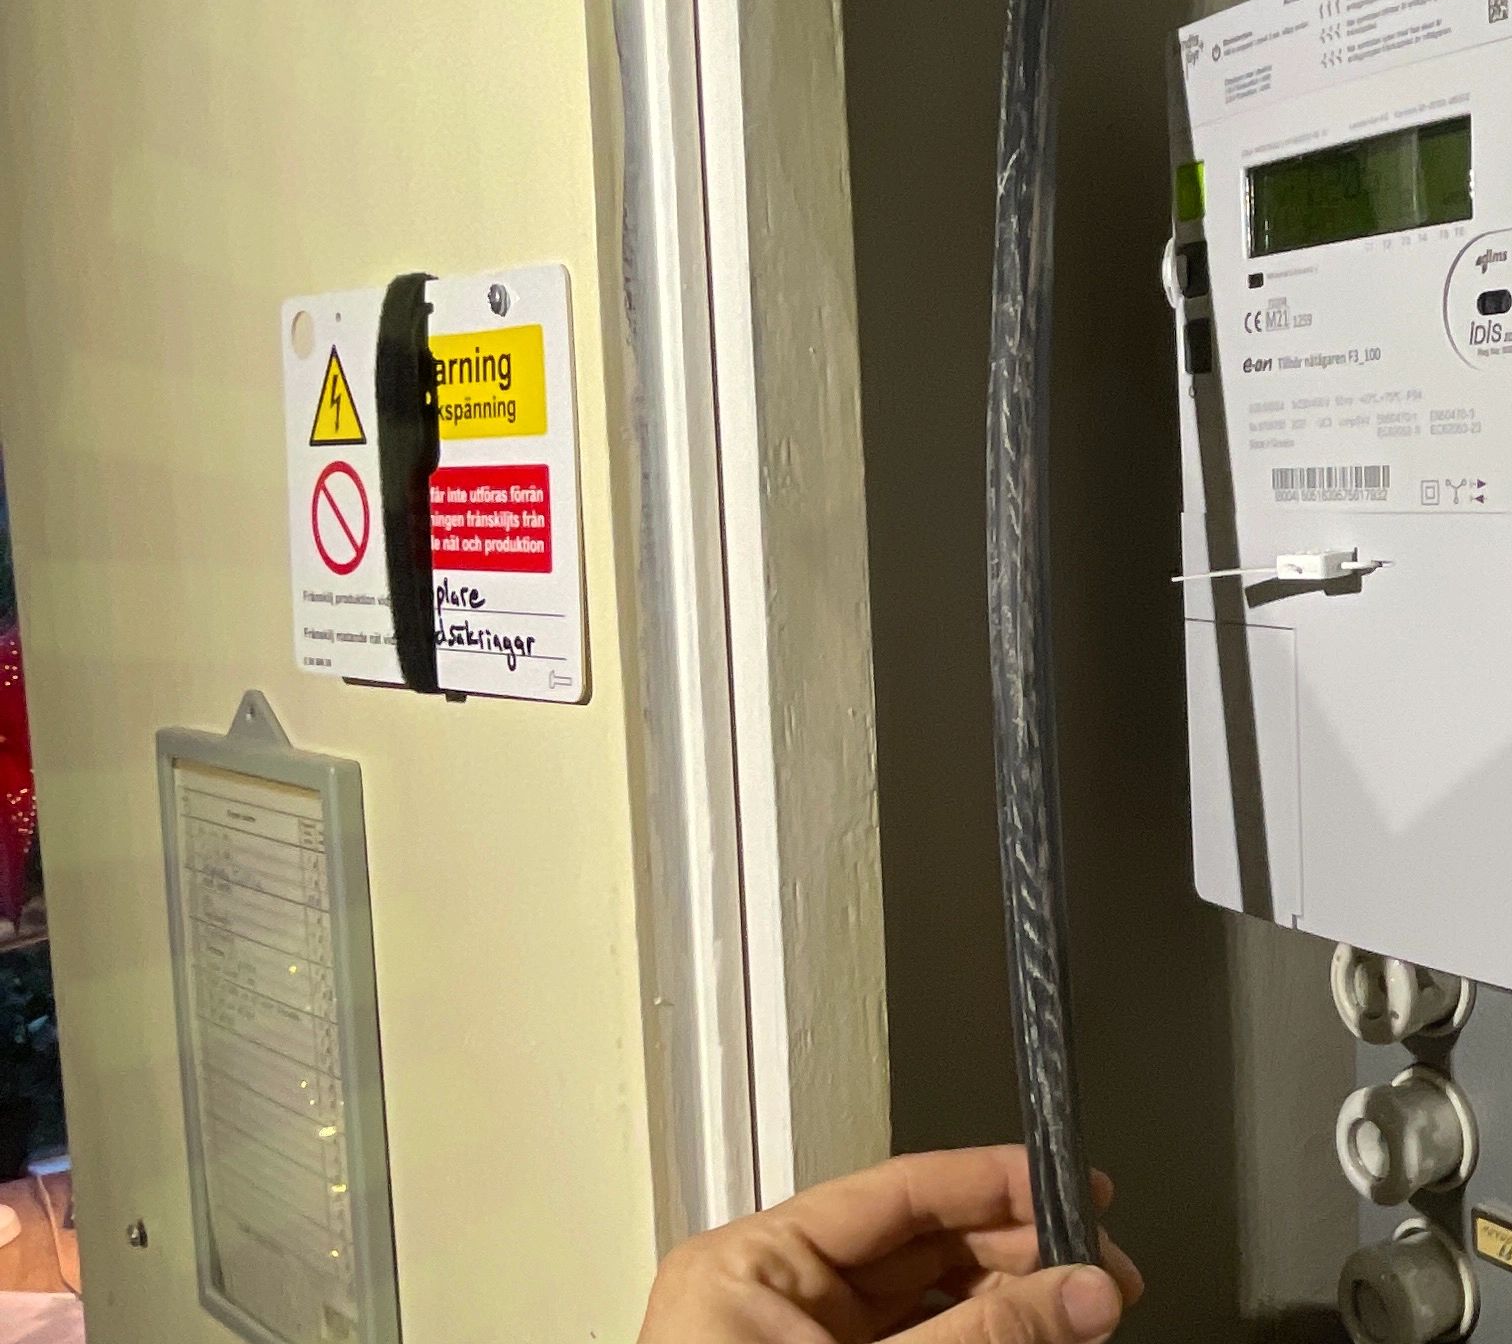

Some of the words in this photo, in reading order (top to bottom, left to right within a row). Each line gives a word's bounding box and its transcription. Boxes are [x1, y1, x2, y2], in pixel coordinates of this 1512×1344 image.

[435, 346, 512, 391] arning
[438, 396, 517, 426] kspänning
[447, 486, 467, 503] inte
[469, 485, 508, 503] utföras
[484, 536, 545, 556] produktion
[437, 577, 485, 616] plare
